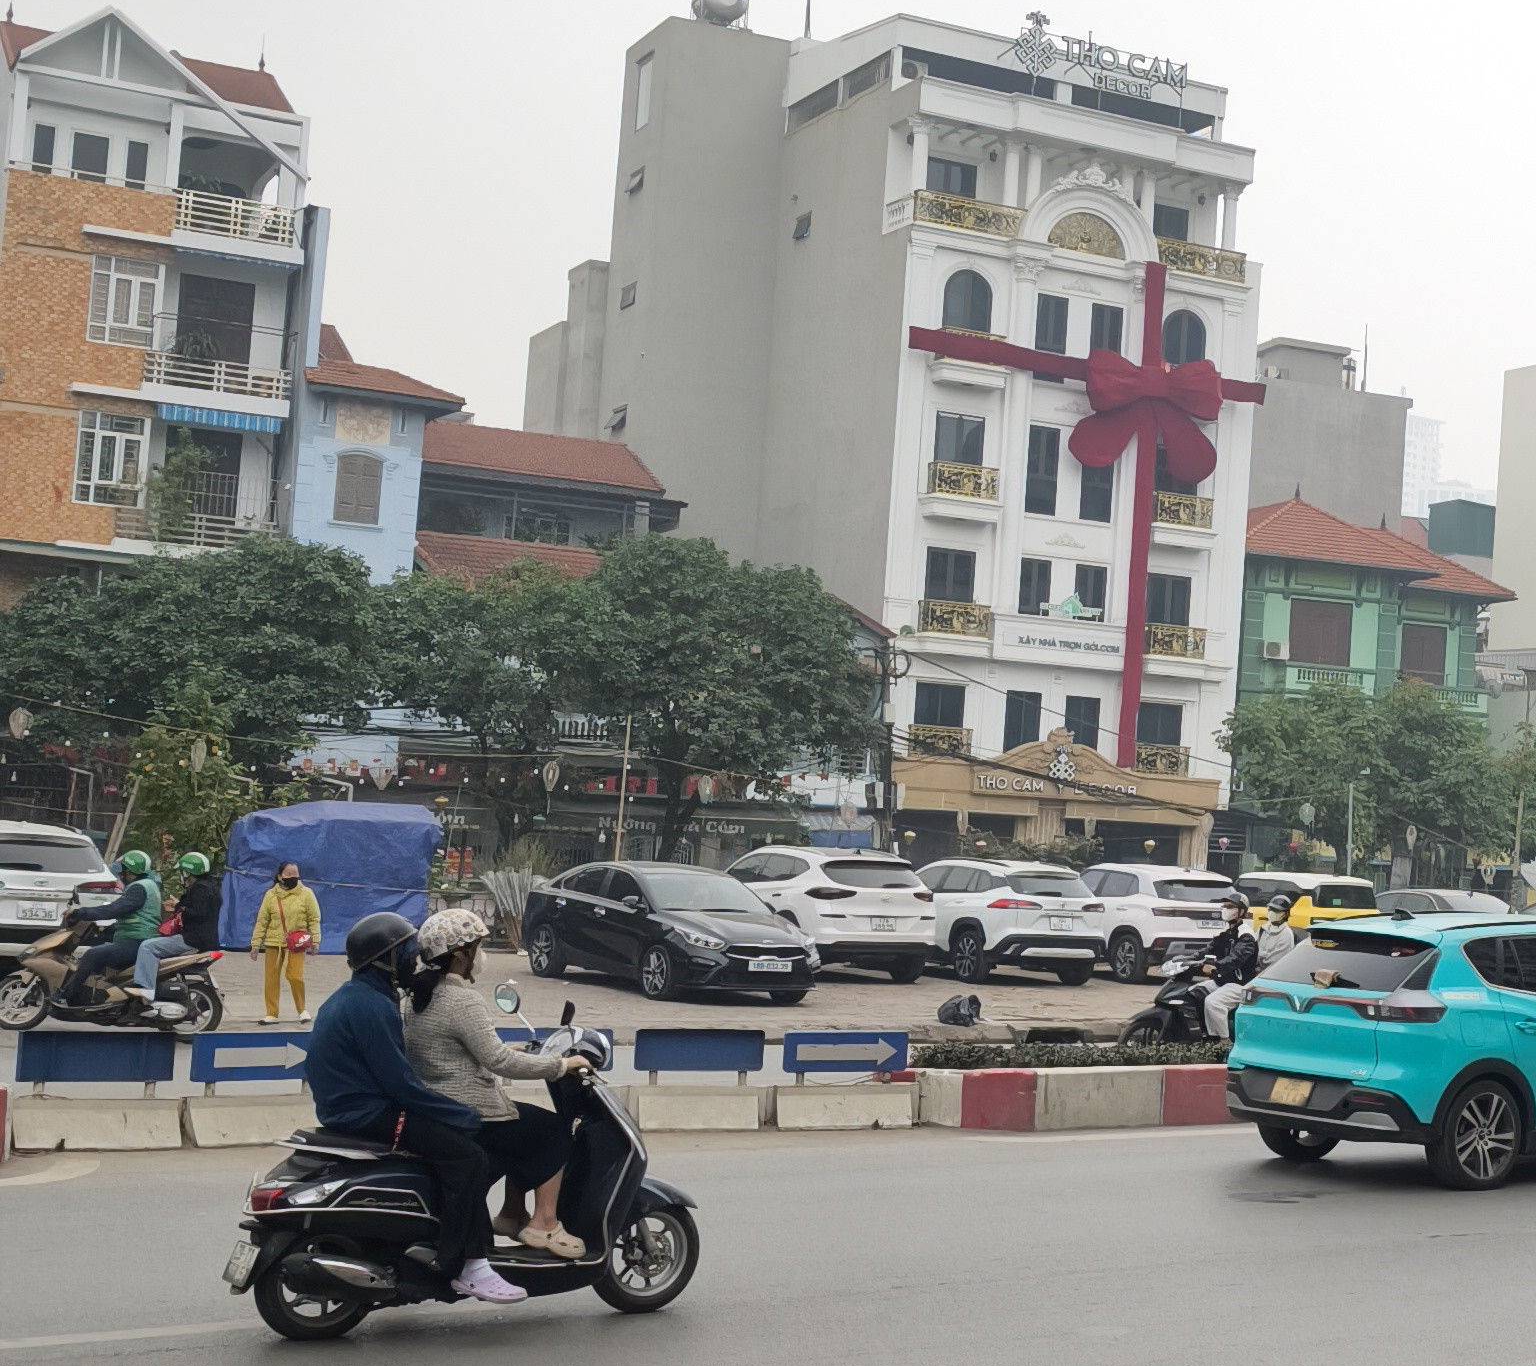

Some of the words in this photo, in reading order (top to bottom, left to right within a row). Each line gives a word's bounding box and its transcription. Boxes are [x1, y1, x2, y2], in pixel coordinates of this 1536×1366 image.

[1062, 36, 1119, 70] THO
[1128, 54, 1187, 88] CAM
[1094, 72, 1151, 99] DECOR
[978, 775, 1008, 789] THO
[1012, 777, 1044, 792] CAM
